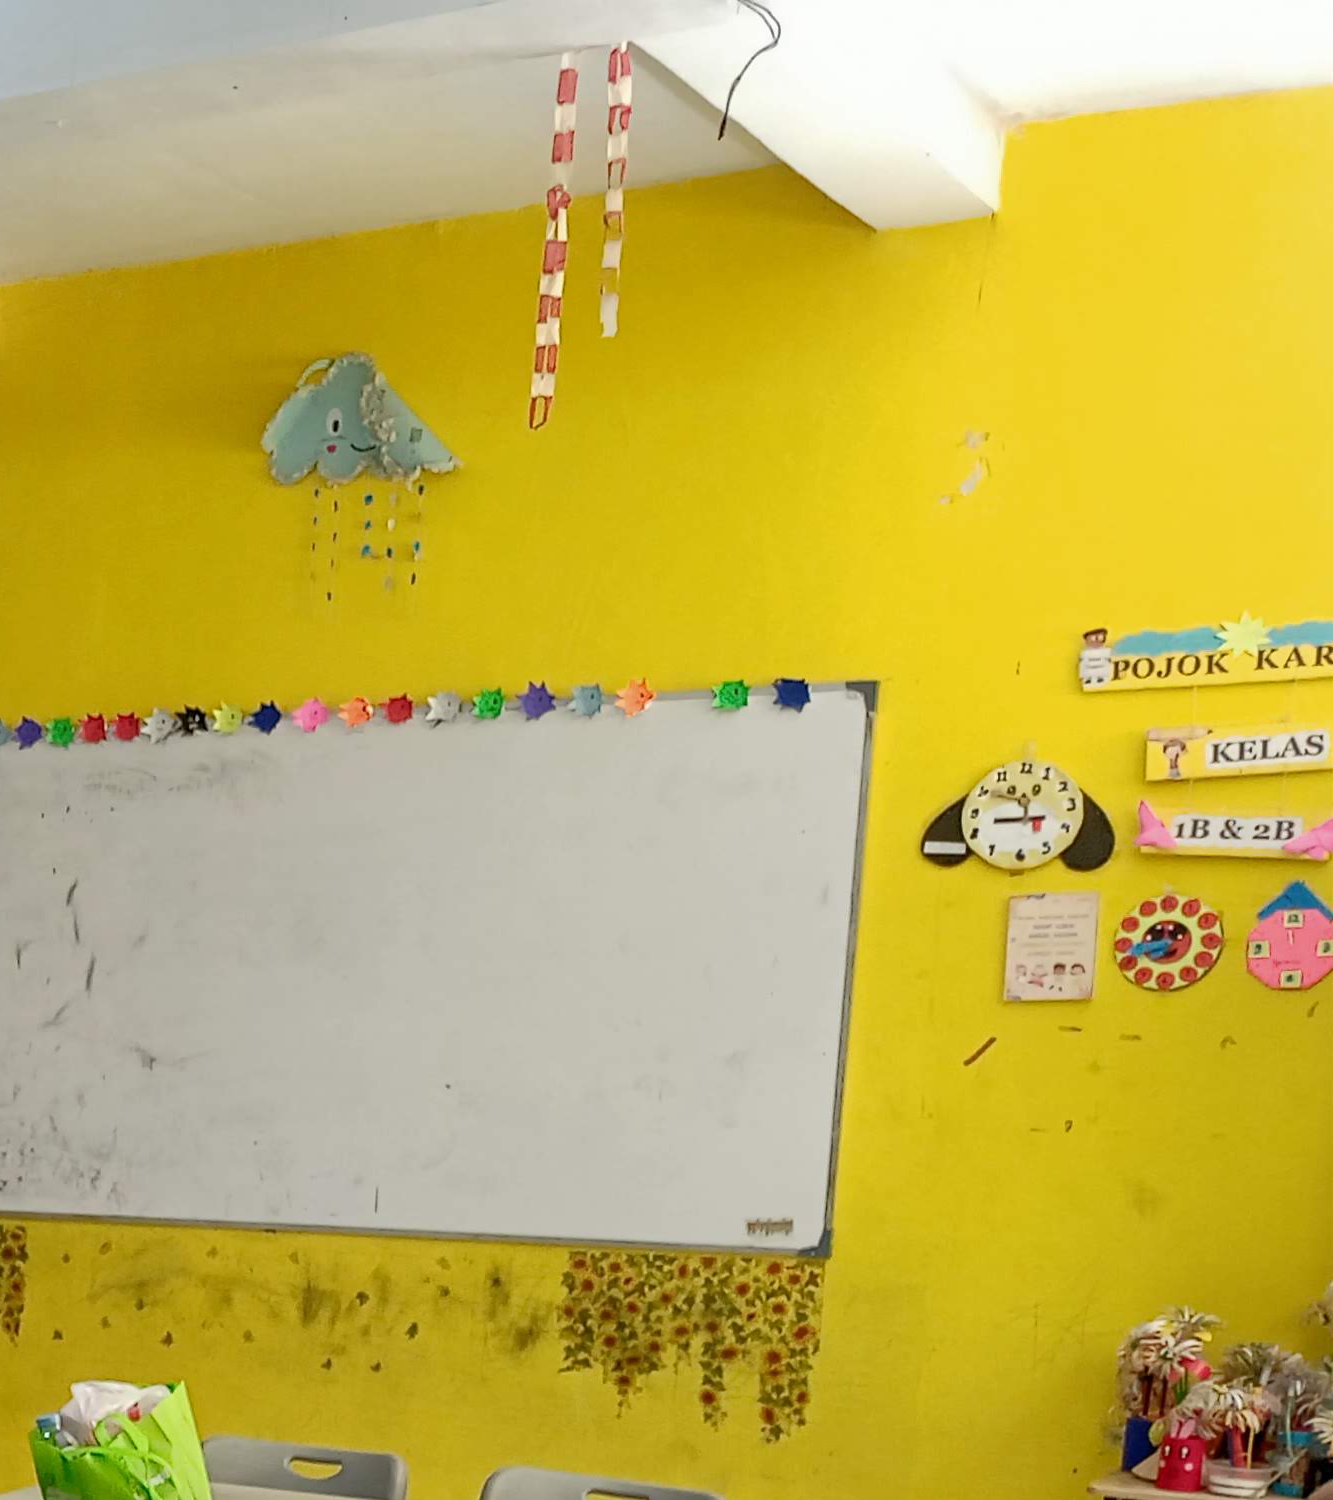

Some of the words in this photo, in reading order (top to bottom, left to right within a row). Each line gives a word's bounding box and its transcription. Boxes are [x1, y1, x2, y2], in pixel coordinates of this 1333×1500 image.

[1111, 652, 1229, 681] POJOK
[1211, 734, 1325, 764] KELAS
[1020, 762, 1033, 774] 12
[1058, 781, 1068, 792] 2
[1066, 798, 1076, 811] 3
[1175, 818, 1211, 839] 1B
[1219, 818, 1244, 840] &
[1252, 820, 1295, 841] 2B
